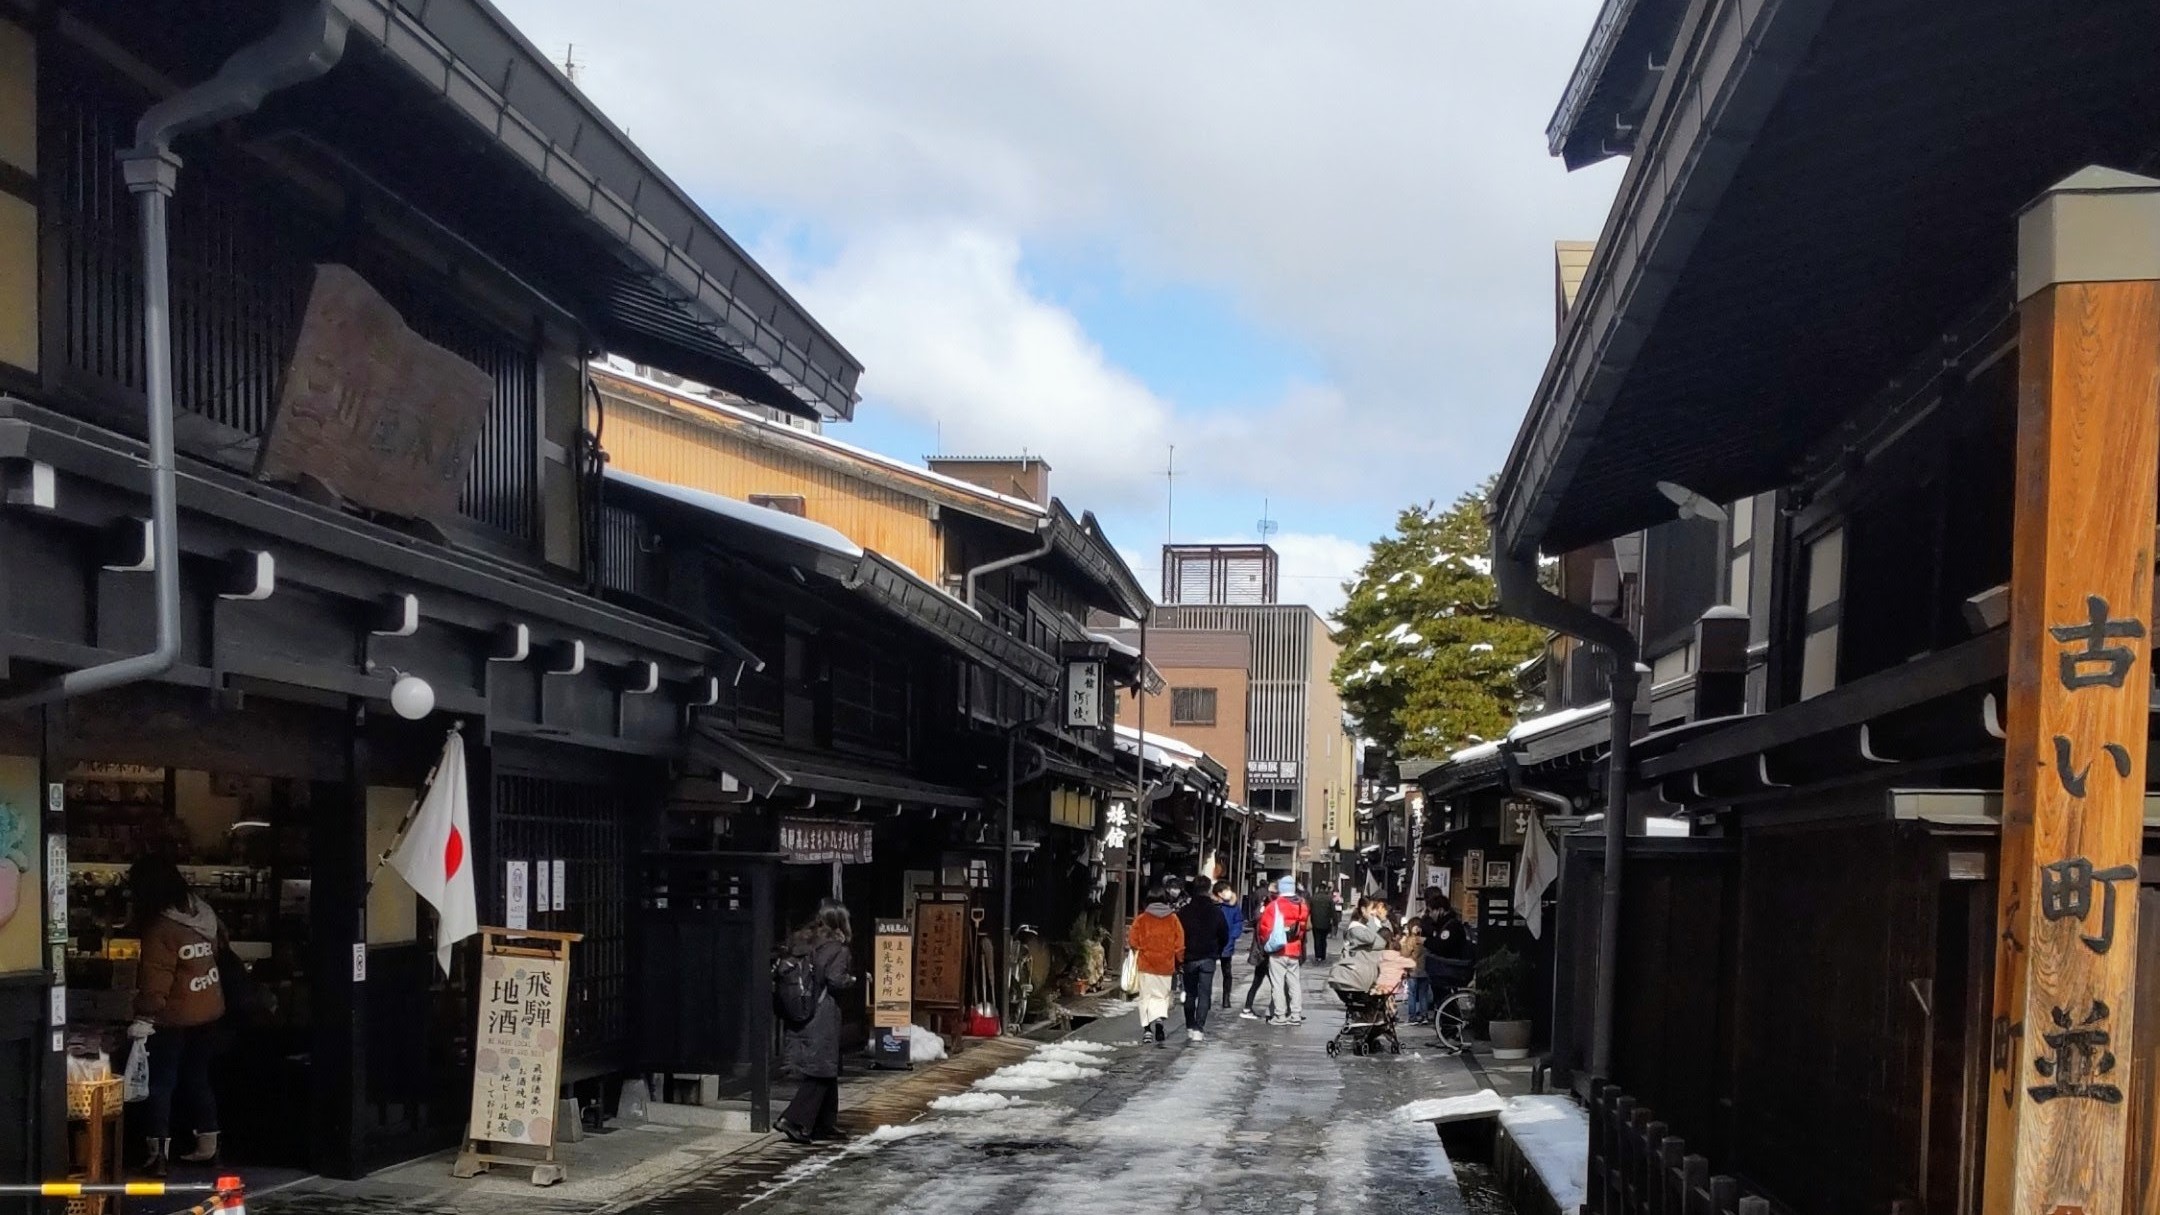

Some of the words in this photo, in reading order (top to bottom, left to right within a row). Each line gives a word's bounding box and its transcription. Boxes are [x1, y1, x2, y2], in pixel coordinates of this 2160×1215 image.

[1105, 802, 1130, 848] 旅館
[2027, 595, 2146, 1106] 古い町並
[882, 941, 893, 997] 観光案内所
[896, 941, 905, 996] まちかど
[488, 977, 520, 1035] 地酒
[521, 970, 552, 1028] 飛騨
